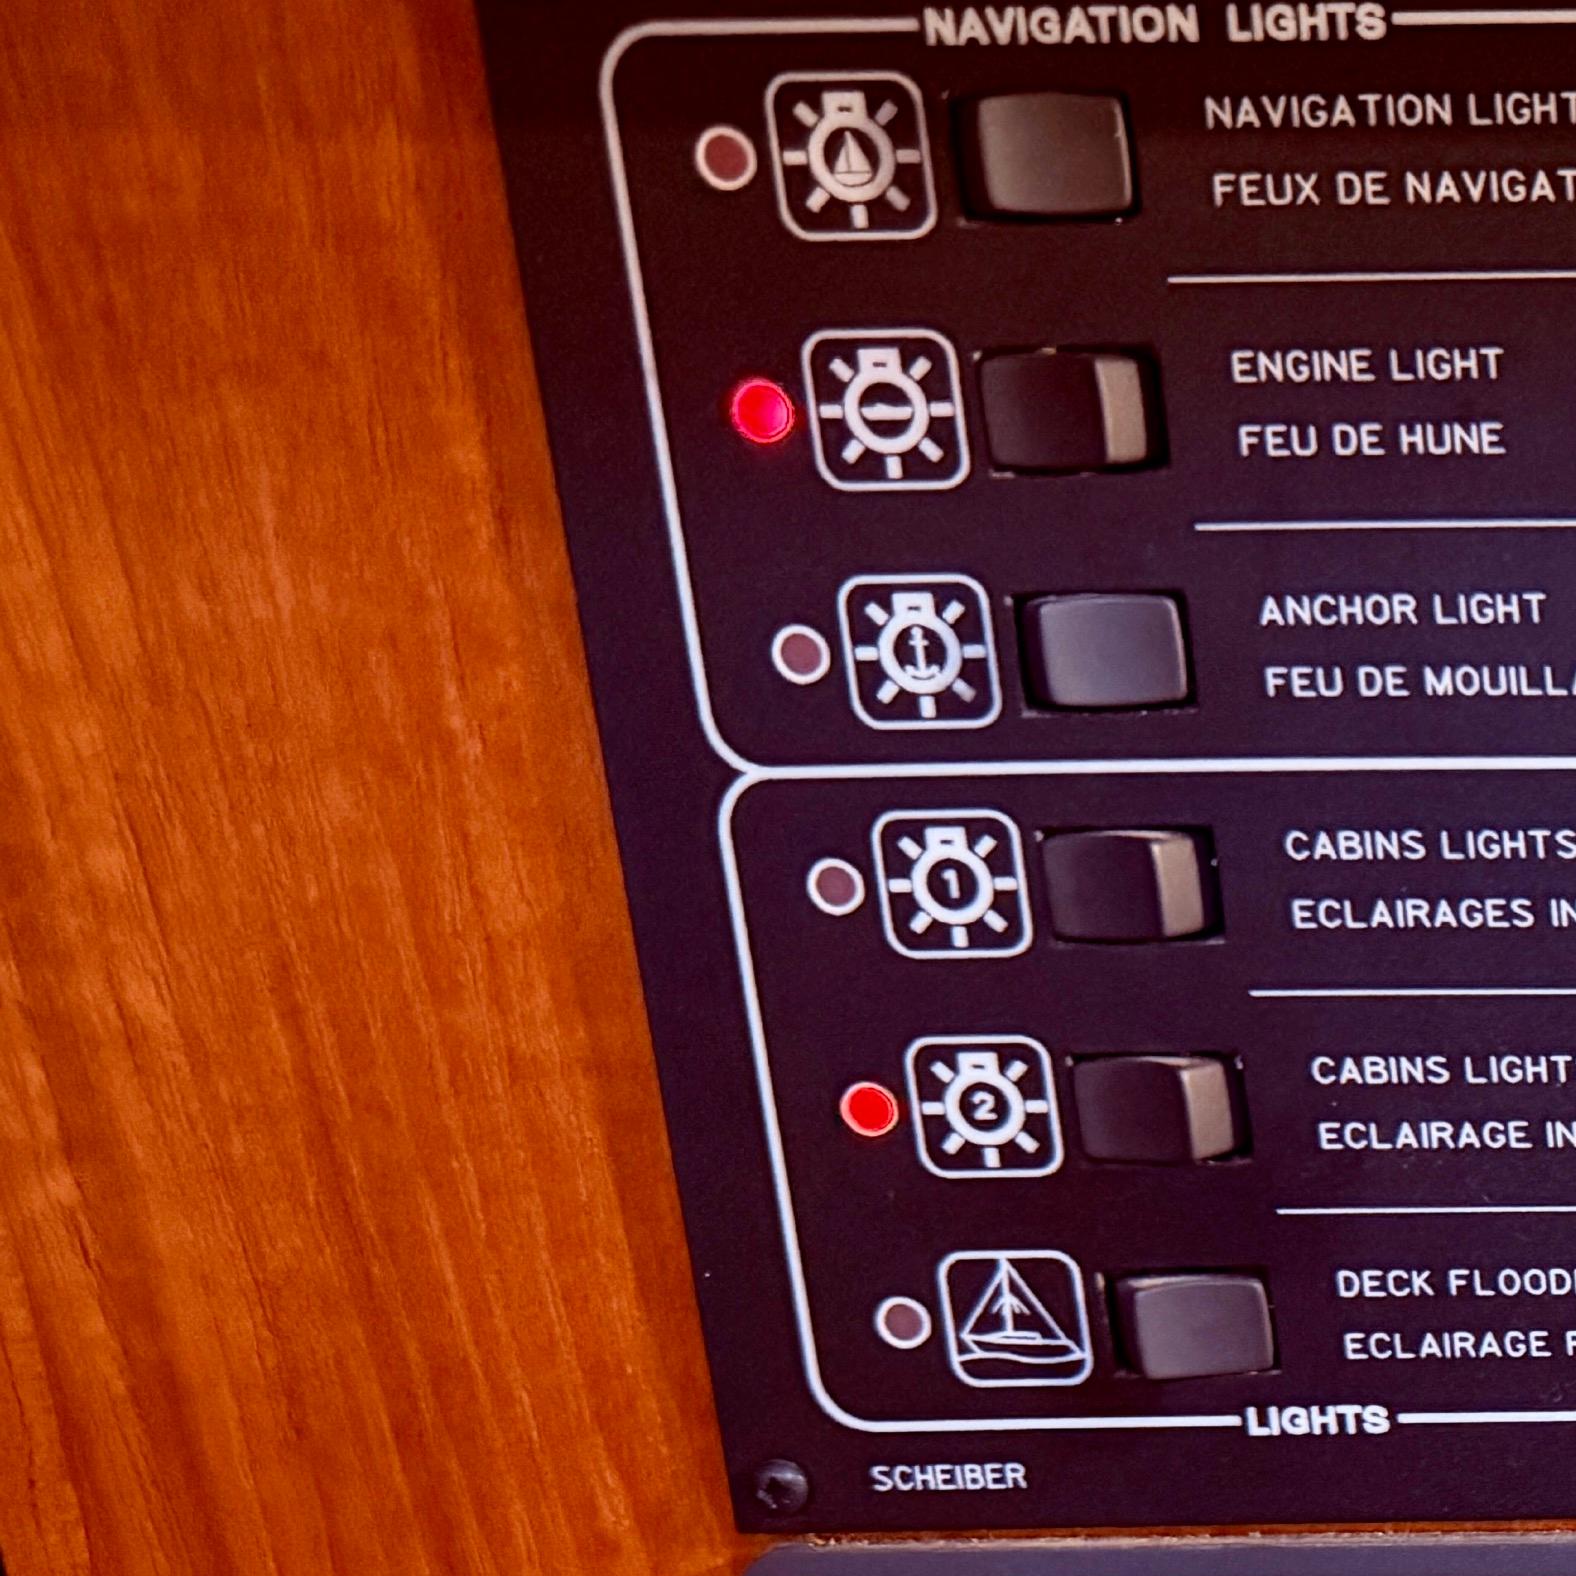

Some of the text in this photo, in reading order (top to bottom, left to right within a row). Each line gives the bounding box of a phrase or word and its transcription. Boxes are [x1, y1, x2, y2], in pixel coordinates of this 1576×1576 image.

[924, 2, 1387, 46] NAVIGATION LIGHTS
[1205, 93, 1453, 129] NAVIGATION
[1213, 173, 1320, 206] FEUX
[1336, 171, 1391, 205] DE
[1231, 347, 1504, 383] ENGINE LIGHT
[1238, 422, 1506, 457] FEU DE HUNE
[1260, 592, 1546, 626] ANCHOR LIGHT
[1265, 666, 1343, 698] FEU
[1357, 665, 1410, 697] DE
[1285, 829, 1426, 861] CABINS
[942, 869, 960, 899] 1
[1292, 898, 1535, 929] ECLAIRAGES
[1311, 1055, 1450, 1085] CABINS
[971, 1091, 998, 1121] 2
[1318, 1120, 1533, 1150] ECLAIRAGE
[1336, 1269, 1435, 1298] DECK
[1344, 1330, 1552, 1360] ECLAIRAGE
[1246, 1404, 1391, 1437] LIGHTS
[871, 1462, 1027, 1492] SCHEIBER
